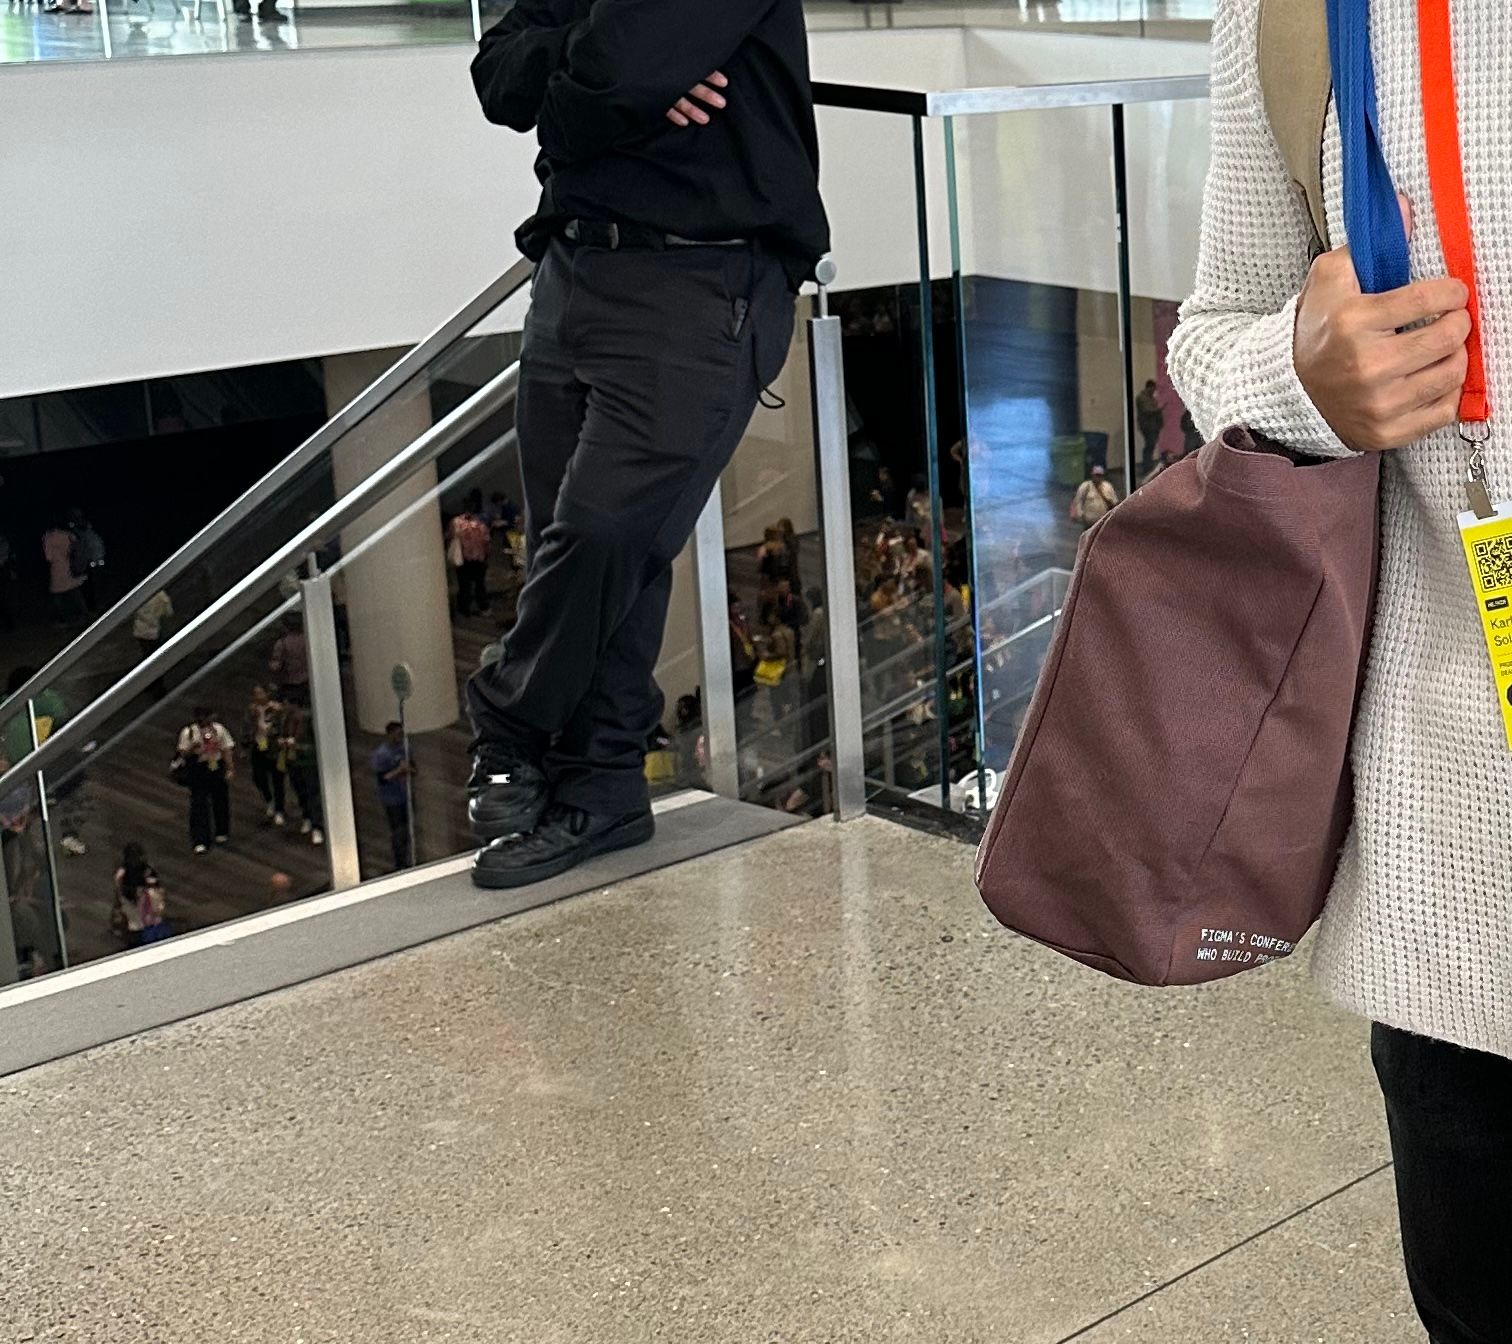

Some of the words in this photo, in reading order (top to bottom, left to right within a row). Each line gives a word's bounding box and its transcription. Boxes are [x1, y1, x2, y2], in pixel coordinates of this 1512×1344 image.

[1201, 928, 1246, 944] FIGMA'S
[1197, 947, 1218, 961] WHO
[1221, 949, 1252, 963] BUILD
